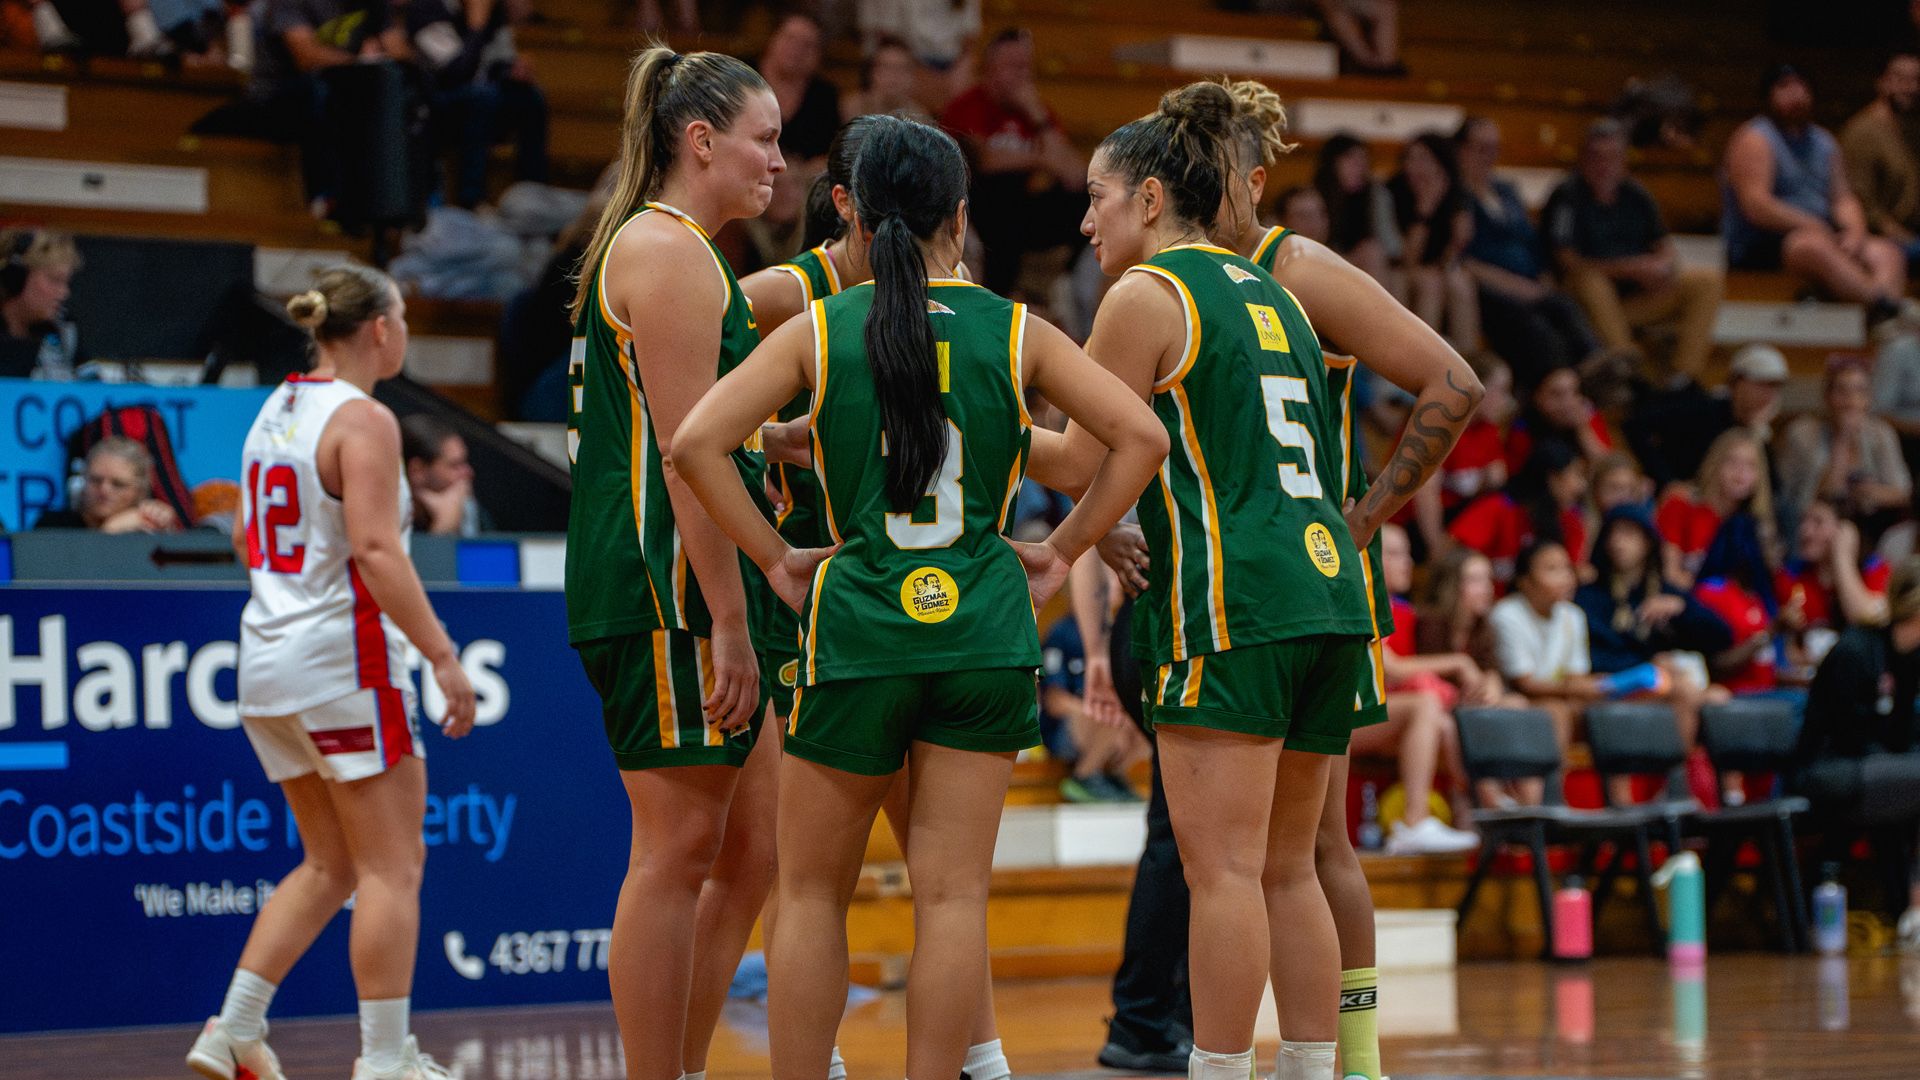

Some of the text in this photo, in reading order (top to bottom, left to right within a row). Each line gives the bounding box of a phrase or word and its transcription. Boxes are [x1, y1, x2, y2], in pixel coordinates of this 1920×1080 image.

[14, 393, 197, 450] COT
[1260, 375, 1323, 500] 5
[881, 417, 965, 550] 3
[245, 459, 307, 574] 12
[912, 592, 947, 605] GUZMAN
[921, 599, 949, 610] GOMEZ
[0, 779, 272, 859] Coastside
[186, 878, 256, 916] Make
[489, 930, 571, 975] 4367
[1340, 993, 1374, 1007] KE
